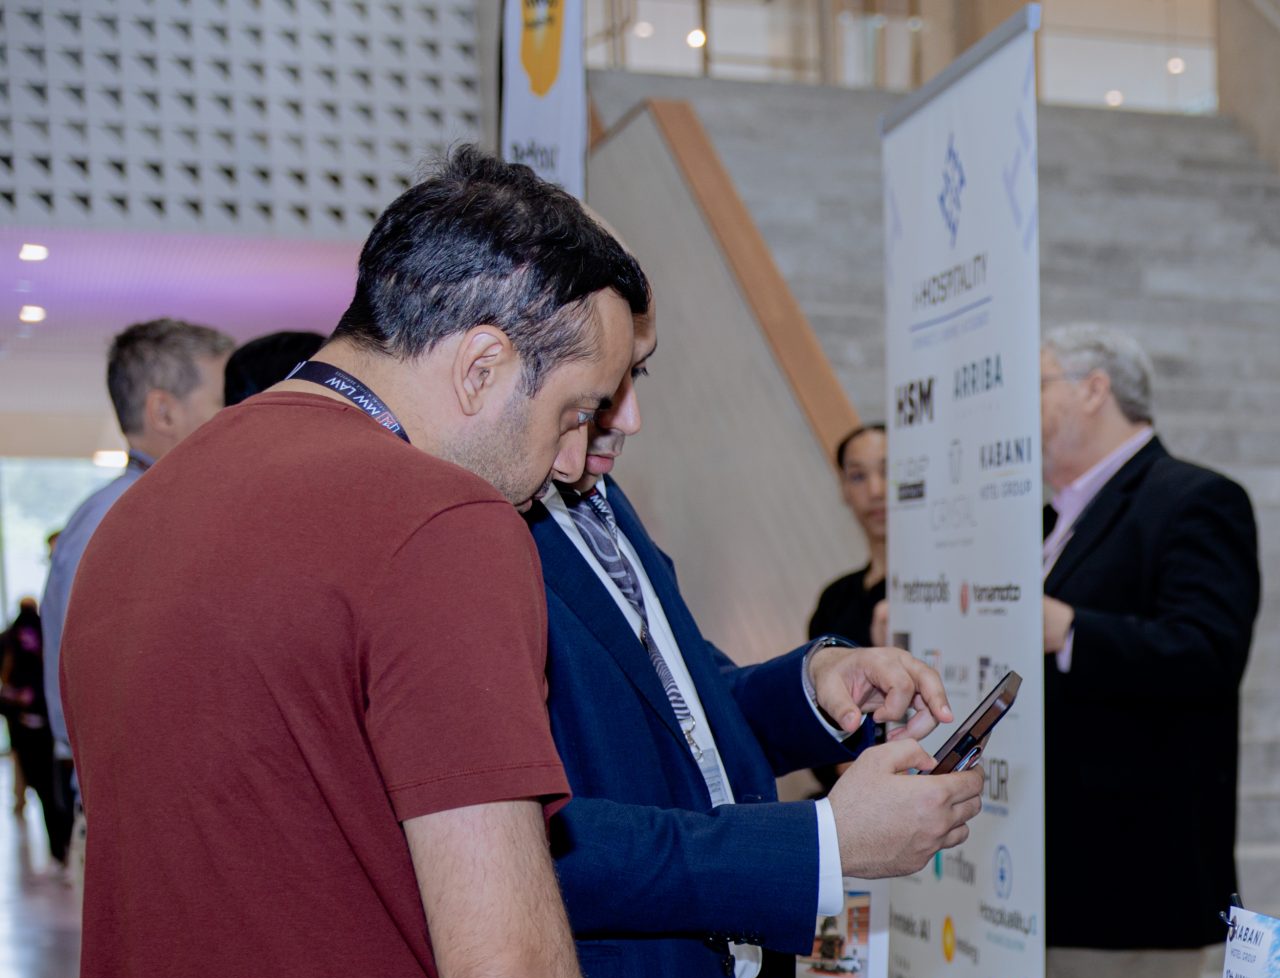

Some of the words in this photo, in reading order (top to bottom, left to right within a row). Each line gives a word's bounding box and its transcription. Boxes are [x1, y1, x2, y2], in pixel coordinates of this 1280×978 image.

[325, 377, 356, 396] LAW
[953, 354, 1004, 400] ARRIBA
[353, 395, 381, 415] MW
[896, 375, 935, 429] HSM
[981, 436, 1032, 470] KABANI
[590, 495, 611, 513] MW
